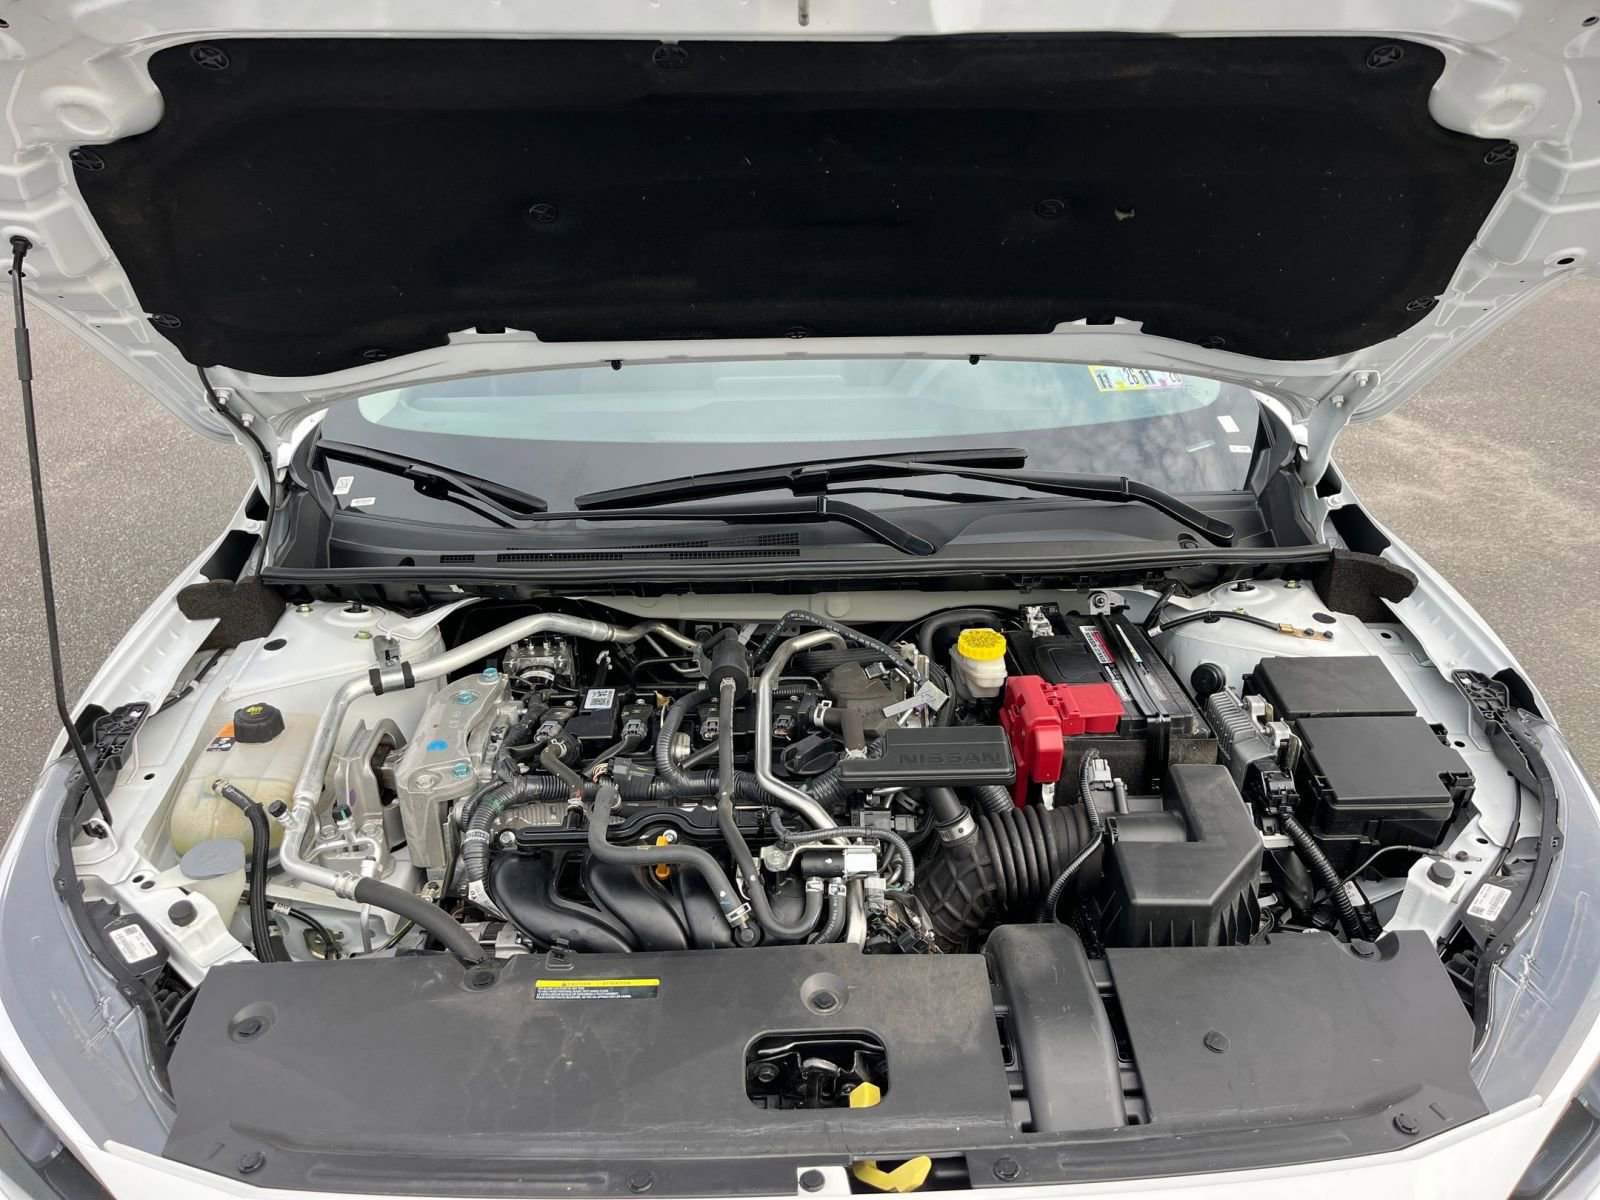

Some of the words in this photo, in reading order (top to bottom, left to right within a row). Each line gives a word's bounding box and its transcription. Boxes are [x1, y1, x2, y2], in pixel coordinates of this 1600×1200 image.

[1097, 373, 1112, 388] 11
[1123, 367, 1139, 384] 26
[1138, 369, 1155, 384] 11
[899, 751, 1003, 765] NISSAN
